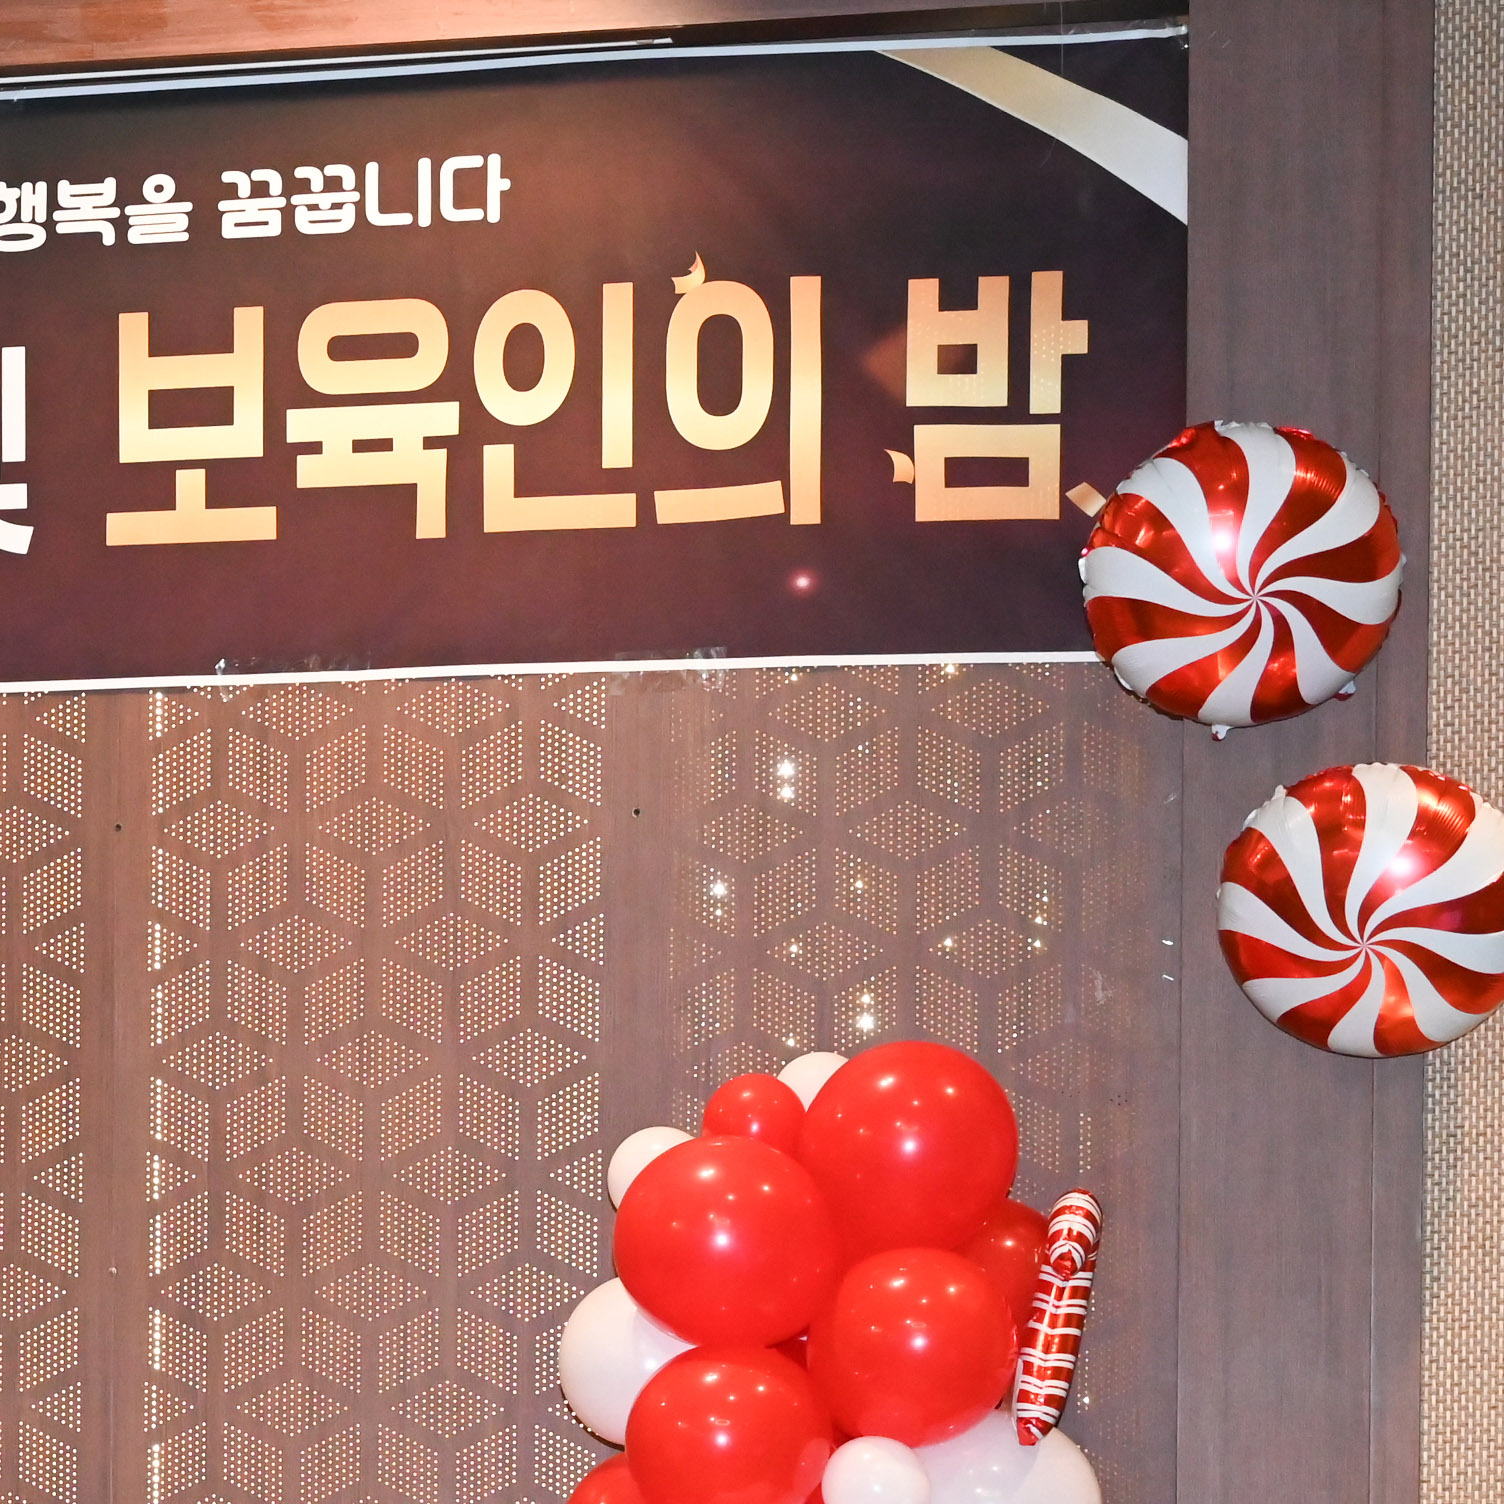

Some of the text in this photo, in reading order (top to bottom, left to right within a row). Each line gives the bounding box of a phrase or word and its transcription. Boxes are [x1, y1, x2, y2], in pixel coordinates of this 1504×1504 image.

[218, 153, 511, 239] 꿈꿉니다
[106, 274, 821, 546] 보육인의
[904, 271, 1090, 521] 밤
